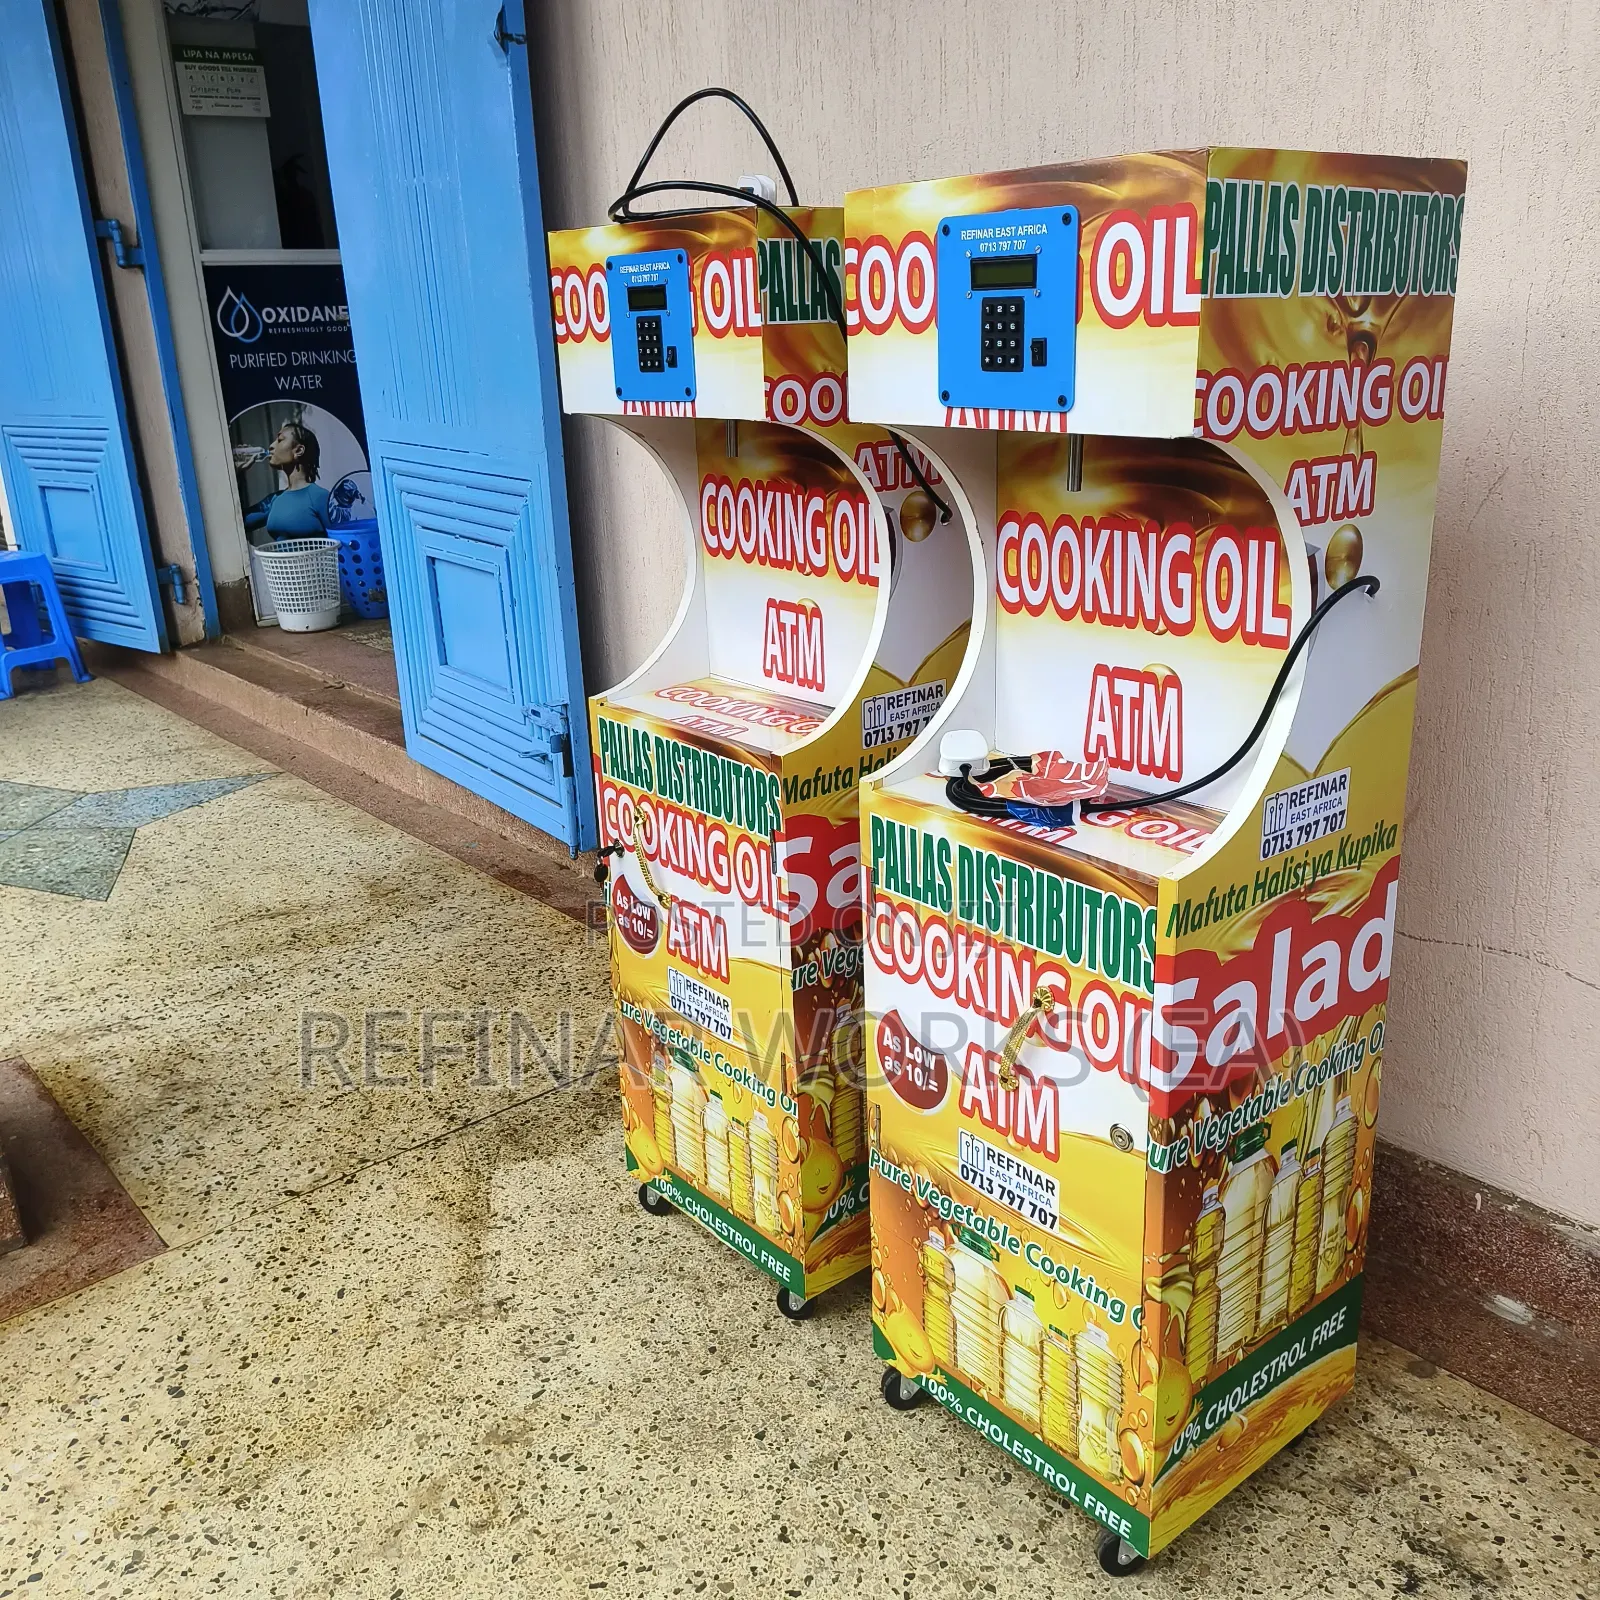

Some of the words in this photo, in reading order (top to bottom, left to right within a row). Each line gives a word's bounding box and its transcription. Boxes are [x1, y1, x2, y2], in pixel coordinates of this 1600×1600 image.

[182, 49, 202, 59] LIPA
[205, 51, 221, 60] NA
[960, 228, 995, 241] REFINAR
[994, 226, 1016, 239] EAST
[1017, 223, 1048, 237] AFRICA
[979, 241, 997, 253] 0713
[997, 240, 1012, 252] 797
[1012, 239, 1027, 251] 707
[1201, 177, 1299, 299] PALLAS
[619, 264, 640, 274] REFINAR
[639, 263, 653, 272] EAST
[652, 261, 671, 271] AFRICA
[1090, 202, 1203, 330] OIL
[261, 304, 350, 324] OXIDANE
[700, 247, 762, 338] OIL
[268, 325, 324, 335] REFRESHINGLY
[229, 351, 288, 369] PURIFIED
[291, 349, 357, 367] DRINKING
[274, 374, 324, 391] WATER
[1397, 354, 1450, 420] OI
[1284, 451, 1377, 526] ATM
[700, 473, 830, 577] COOKING
[831, 490, 880, 588] OIL
[996, 510, 1197, 637] COOKING
[1200, 525, 1293, 650] OIL
[762, 597, 826, 693] ATM
[654, 685, 795, 728] COOKING
[887, 684, 944, 711] REFINAR
[889, 708, 911, 722] EAST
[911, 702, 941, 717] AFRICA
[670, 714, 750, 739] ATM
[864, 725, 895, 748] 0713
[897, 718, 921, 739] 797
[1084, 663, 1183, 783] ATM
[597, 715, 655, 793] PALLAS
[653, 735, 783, 839] DISTRIBUTORS
[782, 766, 854, 806] Mafuta
[1288, 774, 1348, 809] REFINAR
[1289, 806, 1312, 825] EAST
[1312, 796, 1344, 820] AFRICA
[602, 781, 732, 895] COOKING
[1262, 831, 1295, 859] 0713
[1295, 819, 1321, 844] 797
[1322, 811, 1347, 836] 707
[616, 889, 630, 910] As
[1165, 880, 1251, 938] Mafuta
[1250, 849, 1307, 906] Halisi
[1308, 854, 1332, 886] ya
[1335, 819, 1399, 872] Kupika
[617, 915, 632, 929] as
[870, 811, 954, 916] PALLAS
[955, 843, 1158, 995] DISTRIBUTORS
[667, 894, 731, 984] ATM
[866, 893, 1072, 1051] COOKING
[1151, 878, 1400, 1094] Salad
[670, 995, 694, 1023] 0713
[693, 1008, 714, 1033] 797
[713, 1020, 733, 1040] 707
[685, 979, 731, 1014] REFINAR
[687, 994, 704, 1011] EAST
[704, 1003, 730, 1023] AFRICA
[643, 1008, 712, 1066] Vegetable
[713, 1053, 777, 1109] Cooking
[882, 1024, 902, 1052] As
[905, 1034, 937, 1071] Low
[884, 1055, 903, 1077] as
[905, 1065, 939, 1094] 10/=
[1193, 1071, 1293, 1158] Vegetable
[1292, 1034, 1368, 1102] Cooking
[959, 1042, 1060, 1163] ATM
[987, 1147, 1057, 1197] REFINAR
[988, 1166, 1014, 1188] EAST
[1014, 1180, 1054, 1209] AFRICA
[960, 1164, 997, 1198] 0713
[997, 1182, 1028, 1214] 797
[1028, 1202, 1059, 1231] 707
[651, 1174, 685, 1206] 100%
[685, 1195, 761, 1268] CHOLESTROL
[760, 1248, 793, 1283] FREE
[868, 1148, 912, 1191] Pure
[915, 1178, 1021, 1254] Vegetable
[1024, 1240, 1128, 1326] Cooking
[1203, 1343, 1307, 1437] CHOLESTROL
[1308, 1305, 1348, 1357] FREE
[920, 1371, 964, 1416] 100%
[965, 1406, 1081, 1504] CHOLESTROL
[1082, 1490, 1133, 1540] FREE
